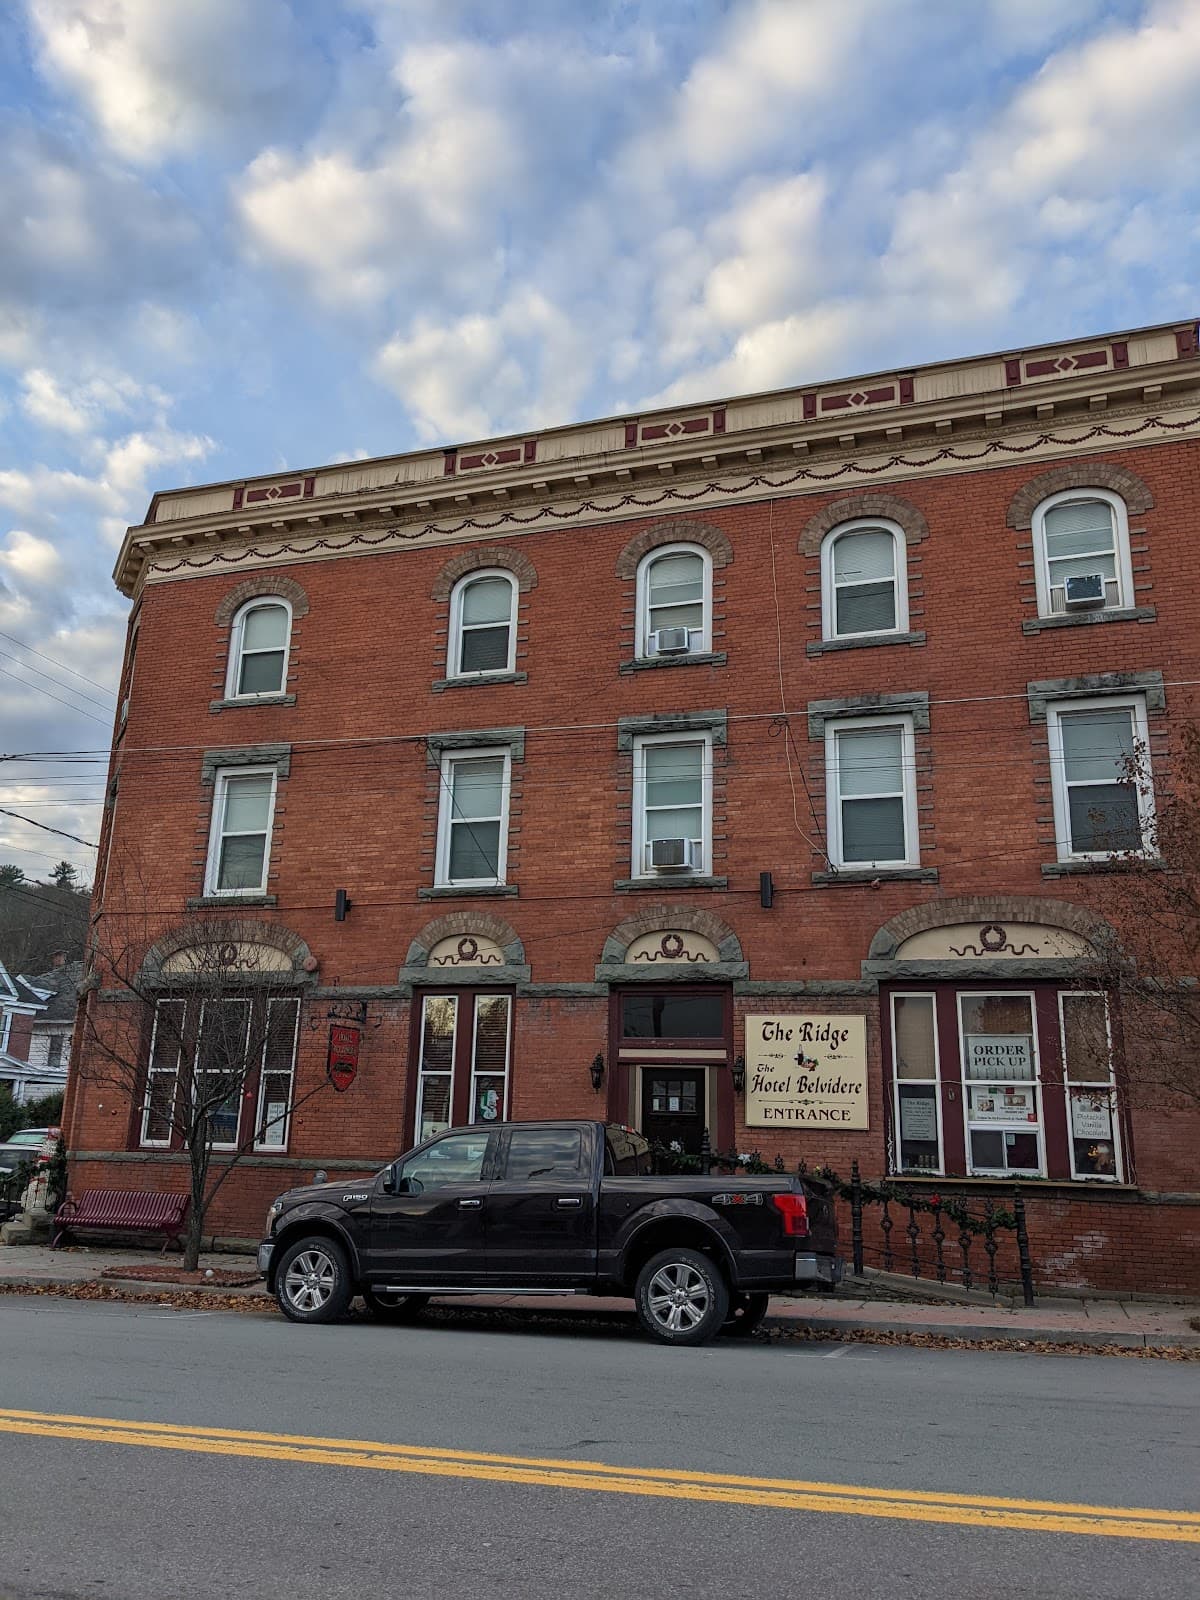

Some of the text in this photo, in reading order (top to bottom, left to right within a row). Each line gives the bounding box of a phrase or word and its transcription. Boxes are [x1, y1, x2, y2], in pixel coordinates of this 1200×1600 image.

[761, 1021, 849, 1050] The Ridge
[974, 1045, 1025, 1056] ORDER
[974, 1057, 1026, 1066] PICK UP
[756, 1063, 775, 1073] The
[751, 1074, 862, 1094] Hotel Belvidere
[763, 1107, 851, 1121] ENTRANCE
